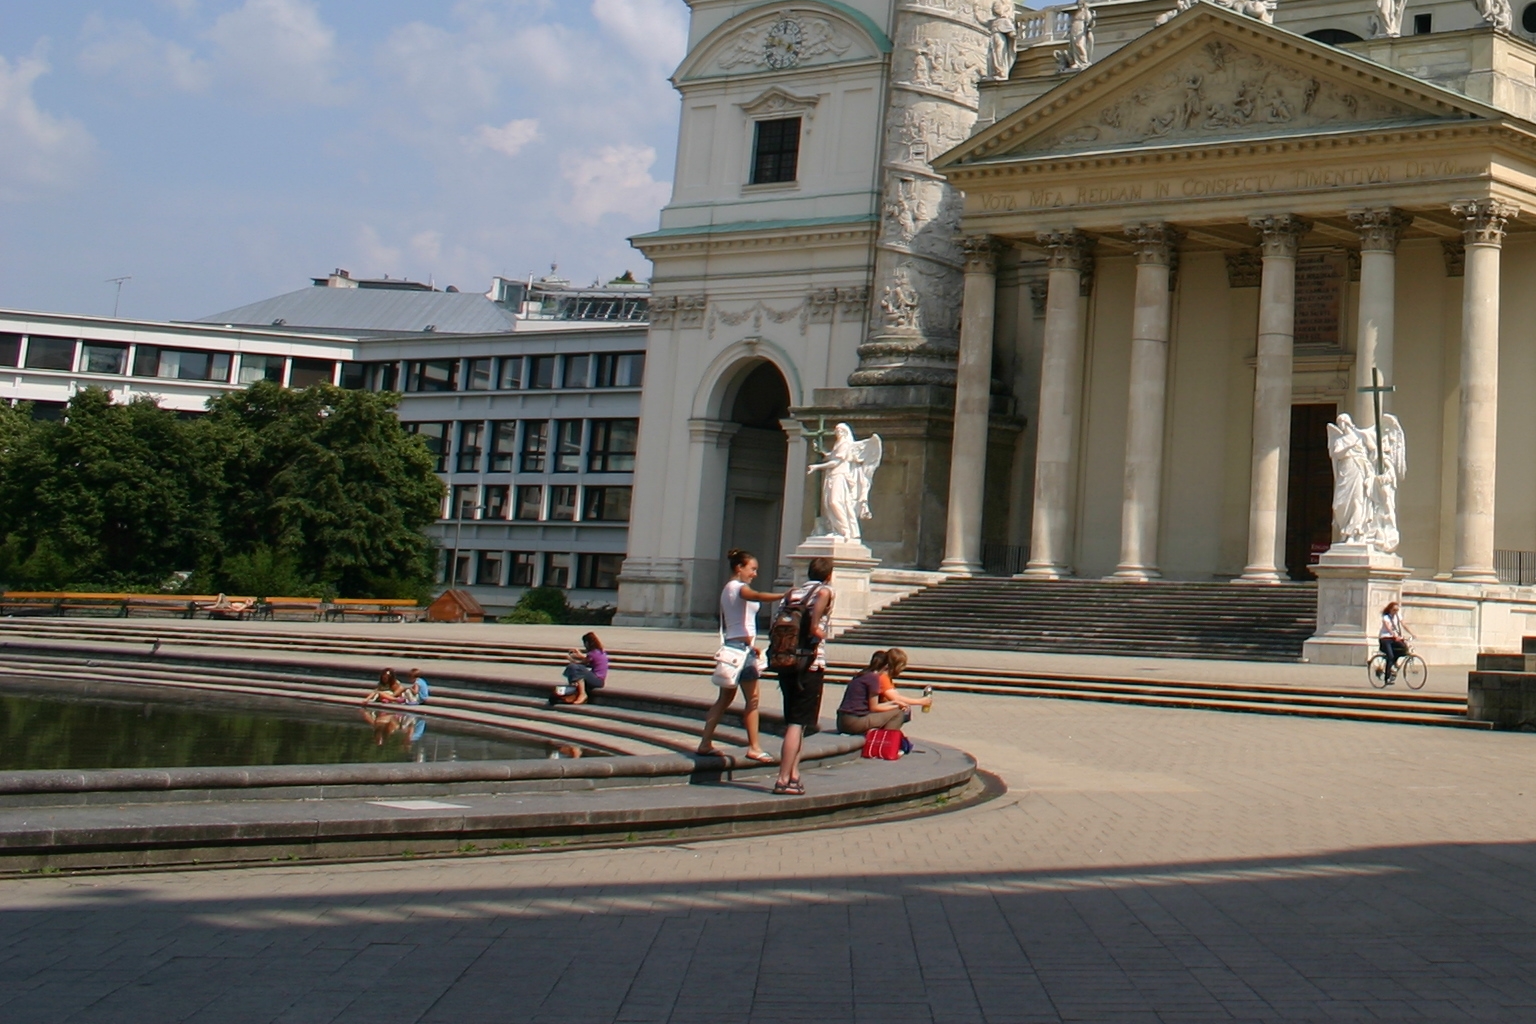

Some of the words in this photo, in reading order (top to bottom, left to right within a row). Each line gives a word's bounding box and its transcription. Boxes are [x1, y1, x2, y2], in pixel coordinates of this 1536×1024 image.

[982, 193, 1017, 210] VOTA
[1030, 189, 1064, 207] MEA
[1077, 184, 1142, 203] REDDAM
[1154, 181, 1170, 198] IN
